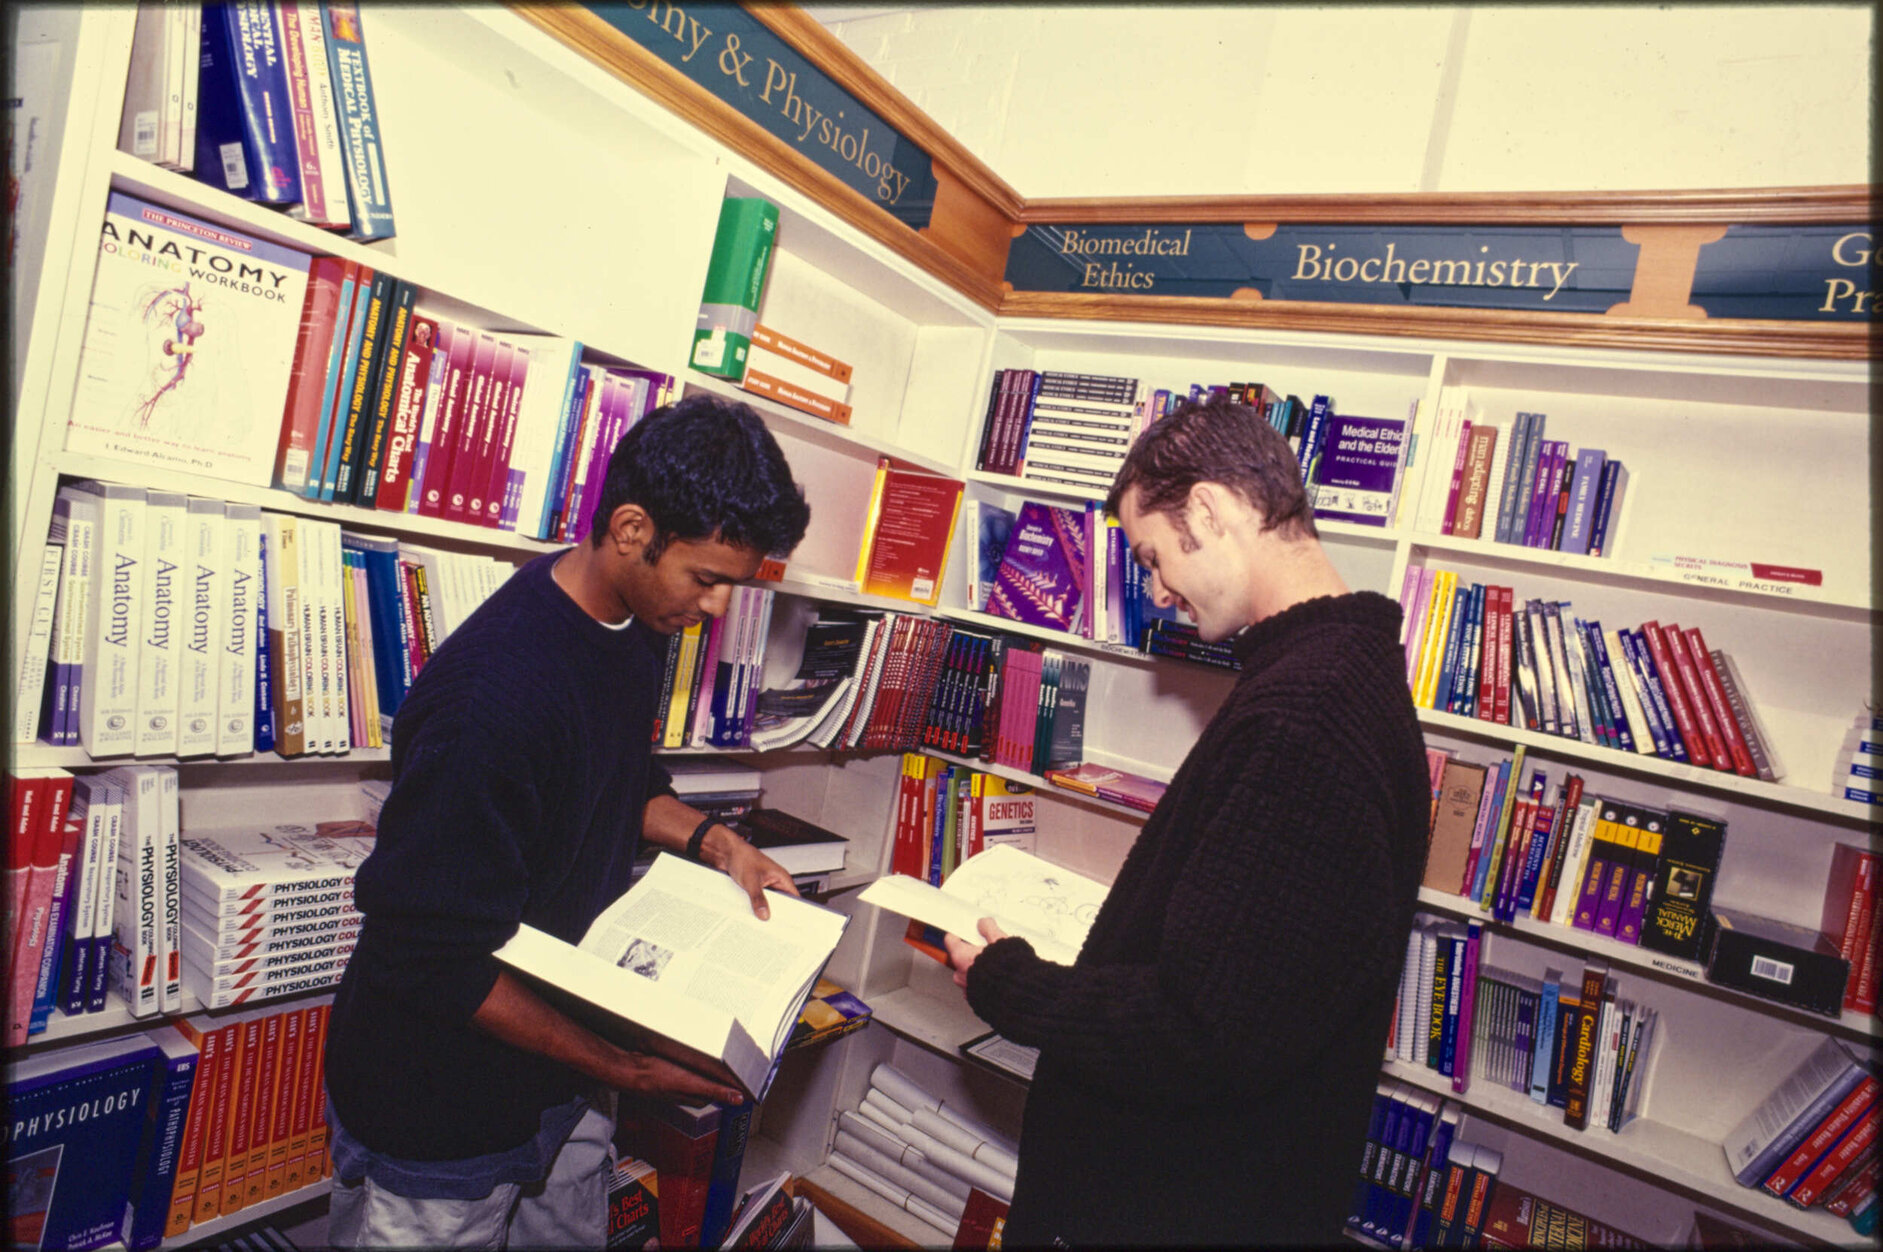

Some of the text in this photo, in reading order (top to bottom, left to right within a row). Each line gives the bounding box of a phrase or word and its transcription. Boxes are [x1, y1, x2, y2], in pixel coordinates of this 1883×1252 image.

[351, 49, 375, 141] TEXTBOOK of
[337, 48, 372, 205] MEDICAL PHYSIOLOGY
[719, 33, 753, 88] &
[759, 57, 912, 205] Physiology
[144, 211, 252, 250] THE PRINCETON REVIEW
[1061, 229, 1191, 257] Biomedical
[101, 221, 288, 289] ANATOMY
[1291, 243, 1579, 301] Biochemistry
[188, 266, 286, 303] WORKBOOK
[1081, 262, 1154, 289] Ethics
[365, 297, 382, 336] ANATOMY
[392, 306, 408, 344] ANATOMY
[362, 338, 374, 356] AND
[388, 346, 400, 363] AND
[351, 357, 370, 414] PHYSIOLOGY
[378, 364, 397, 420] PHYSIOLOGY
[349, 413, 358, 427] The
[376, 420, 385, 434] The
[384, 350, 421, 483] Anatomical Charts
[1342, 424, 1403, 441] Medical Ethic
[114, 444, 150, 457] Edward
[1338, 440, 1357, 451] and
[1358, 441, 1373, 452] the
[1478, 435, 1489, 460] man
[1465, 461, 1487, 505] adapting
[1572, 476, 1590, 539] FAMILY MEDICINE
[38, 549, 59, 598] FIRST
[1739, 580, 1793, 594] PRACTICE
[105, 552, 137, 647] Anatomy
[147, 558, 178, 650] Anatomy
[188, 564, 216, 654] Anatomy
[225, 568, 252, 656] Anatomy
[303, 634, 312, 657] BRAIN
[320, 635, 328, 657] BRAIN
[334, 606, 346, 718] HUMAN BRAIN COLORING BOOK
[305, 658, 314, 696] COLORING
[320, 658, 329, 696] COLORING
[306, 697, 316, 718] BOOK
[322, 697, 331, 718] BOOK
[1720, 675, 1740, 711] DESIRE
[1744, 733, 1761, 760] HEAL
[989, 801, 1034, 821] GENETICS
[53, 853, 72, 897] Anatomy
[141, 846, 155, 928] PHYSIOLOGY
[165, 844, 178, 925] PHYSIOLOGY
[274, 878, 342, 894] PHYSIOLOGY
[273, 892, 341, 909] PHYSIOLOGY
[273, 907, 341, 923] PHYSIOLOGY
[1658, 908, 1698, 926] MANUAL
[28, 906, 44, 947] Physiology
[44, 912, 58, 958] EXAMINATION
[269, 934, 337, 951] PHYSIOLOGY
[273, 921, 340, 938] PHYSIOLOGY
[1656, 916, 1698, 938] MERCK
[267, 949, 336, 966] PHYSIOLOGY
[267, 963, 335, 980] PHYSIOLOGY
[1652, 960, 1699, 978] MEDICINE
[36, 958, 51, 999] COMPANION
[265, 977, 334, 996] PHYSIOLOGY
[1430, 957, 1447, 1041] THE EYE BOOK
[176, 1061, 190, 1073] EBS
[1571, 1014, 1594, 1086] Cardiology
[158, 1107, 182, 1176] PATHOPHYSIOLOGY
[617, 1203, 648, 1228] Charts
[621, 1189, 643, 1209] Best
